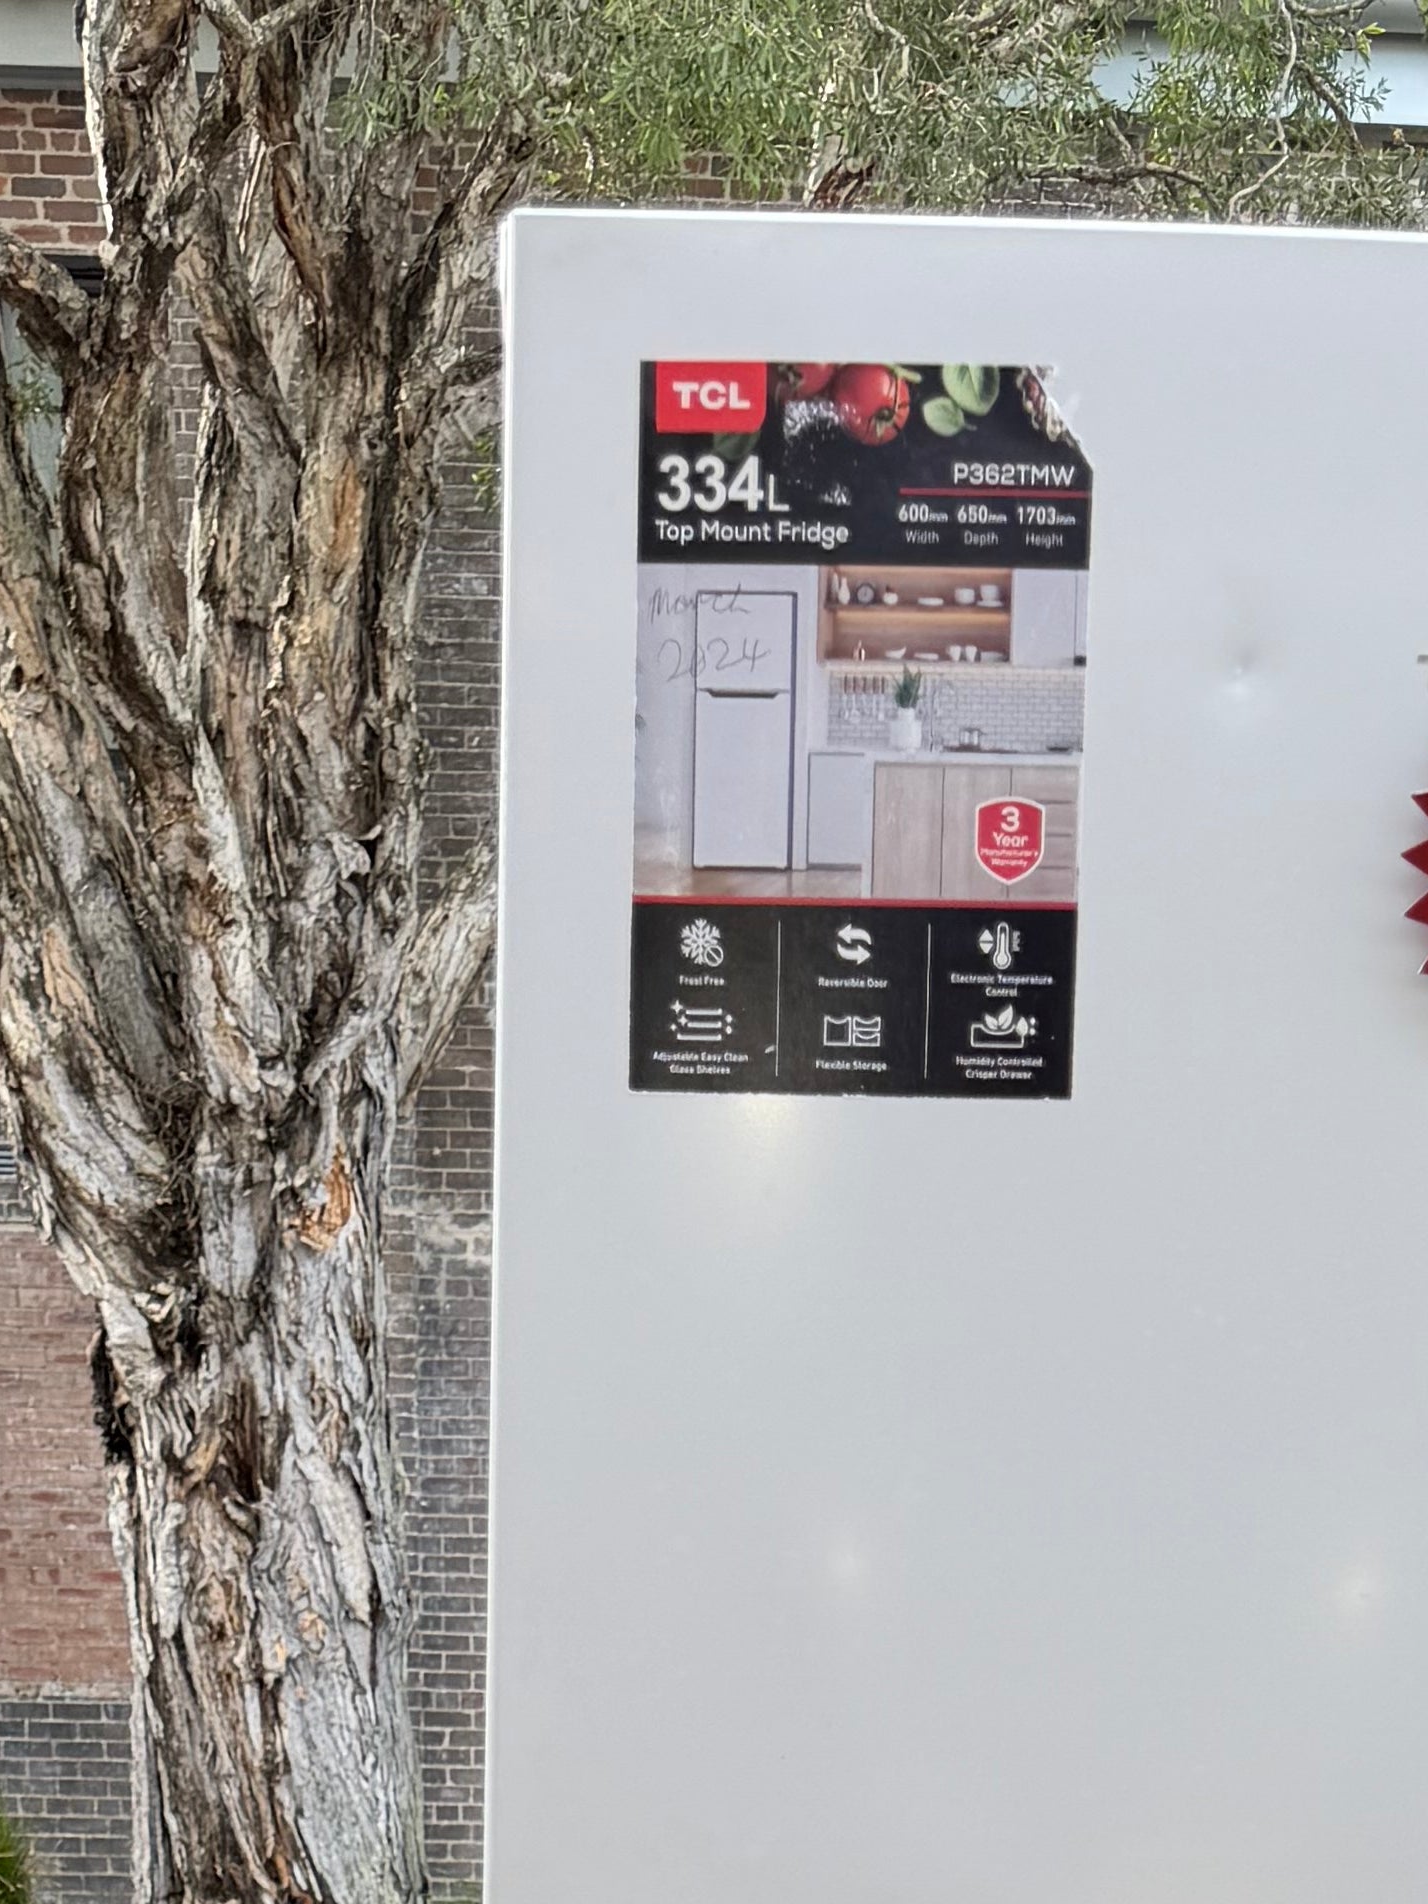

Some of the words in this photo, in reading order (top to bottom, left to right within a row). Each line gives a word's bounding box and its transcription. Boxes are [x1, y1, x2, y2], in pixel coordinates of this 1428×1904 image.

[672, 382, 751, 411] TCL
[953, 462, 1075, 487] P362TMW
[655, 519, 695, 546] Top
[701, 520, 772, 543] Mount
[778, 521, 850, 552] Fridge
[905, 530, 940, 545] Width
[964, 530, 999, 547] Depth
[1025, 532, 1064, 550] Height
[657, 637, 771, 682] 2024
[1000, 805, 1020, 833] 3
[992, 831, 1029, 848] Year
